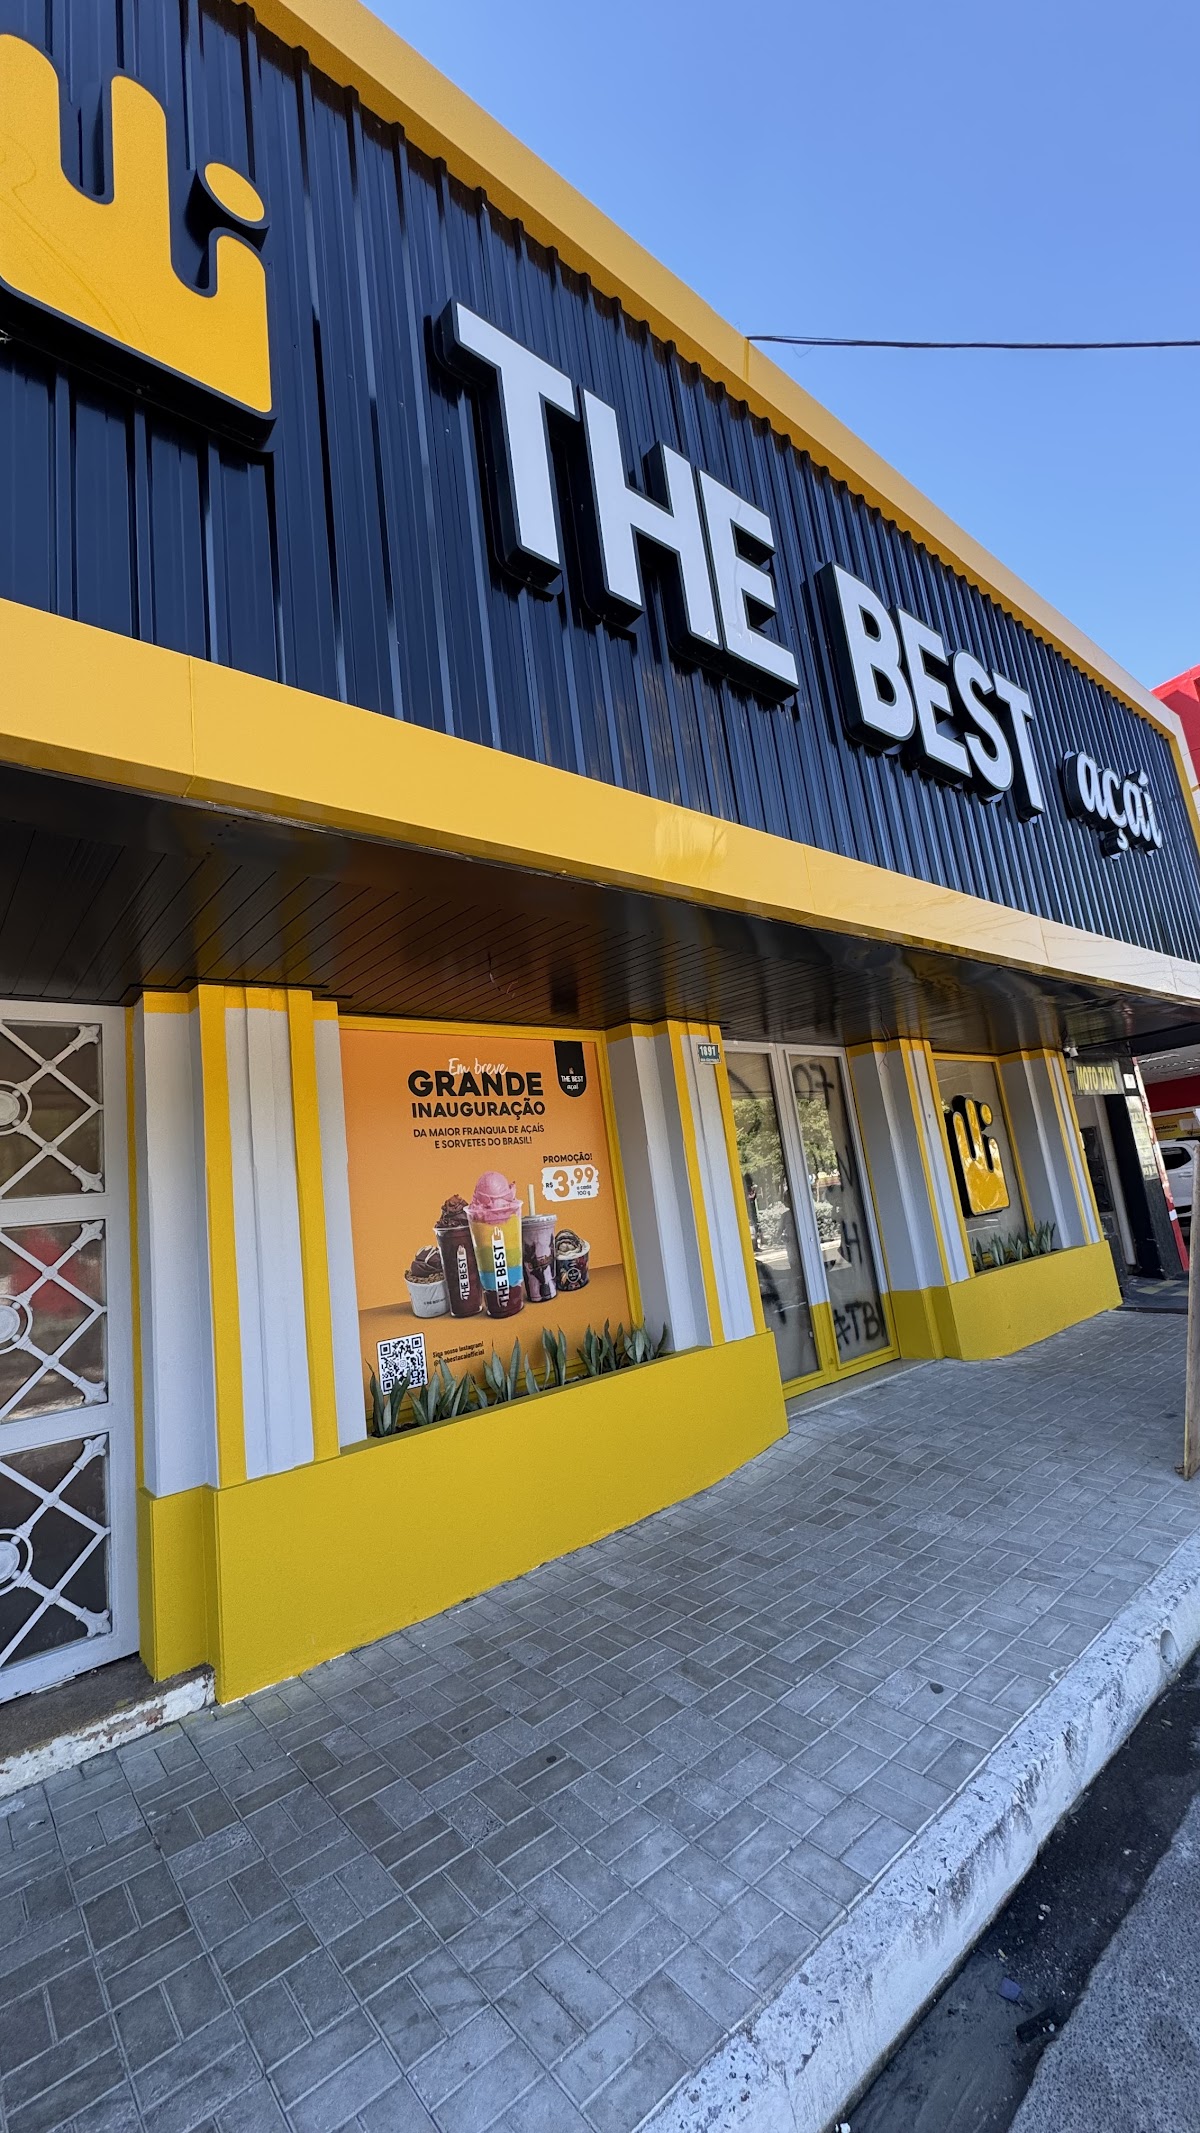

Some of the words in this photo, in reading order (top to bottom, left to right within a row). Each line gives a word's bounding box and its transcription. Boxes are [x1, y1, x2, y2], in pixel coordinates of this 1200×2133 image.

[455, 302, 799, 687] THE
[833, 562, 1044, 812] BEST
[699, 1045, 716, 1057] 1891
[448, 1057, 470, 1076] Em
[473, 1057, 508, 1076] breve
[407, 1069, 544, 1097] GRANDE
[560, 1075, 571, 1083] THE
[571, 1075, 584, 1083] BEST
[1075, 1065, 1099, 1091] MOTO
[1097, 1066, 1117, 1090] TAXI
[411, 1097, 546, 1120] INAUGURAÇÃO
[413, 1128, 427, 1138] DA
[429, 1127, 461, 1137] MAIOR
[462, 1125, 506, 1136] FRANQUIA
[508, 1125, 519, 1134] DE
[520, 1122, 545, 1135] AÇAÍS
[434, 1140, 440, 1149] E
[441, 1137, 487, 1148] SORVETES
[487, 1137, 501, 1146] DO
[502, 1136, 532, 1146] BRASIL!
[542, 1151, 593, 1163] PROMOÇÃO!
[552, 1166, 594, 1198] 3,99
[458, 1258, 468, 1280] BEST
[493, 1245, 507, 1278] BEST
[460, 1281, 470, 1300] THE
[497, 1280, 510, 1306] THE
[432, 1351, 444, 1359] Siga
[458, 1340, 484, 1352] Instagram!
